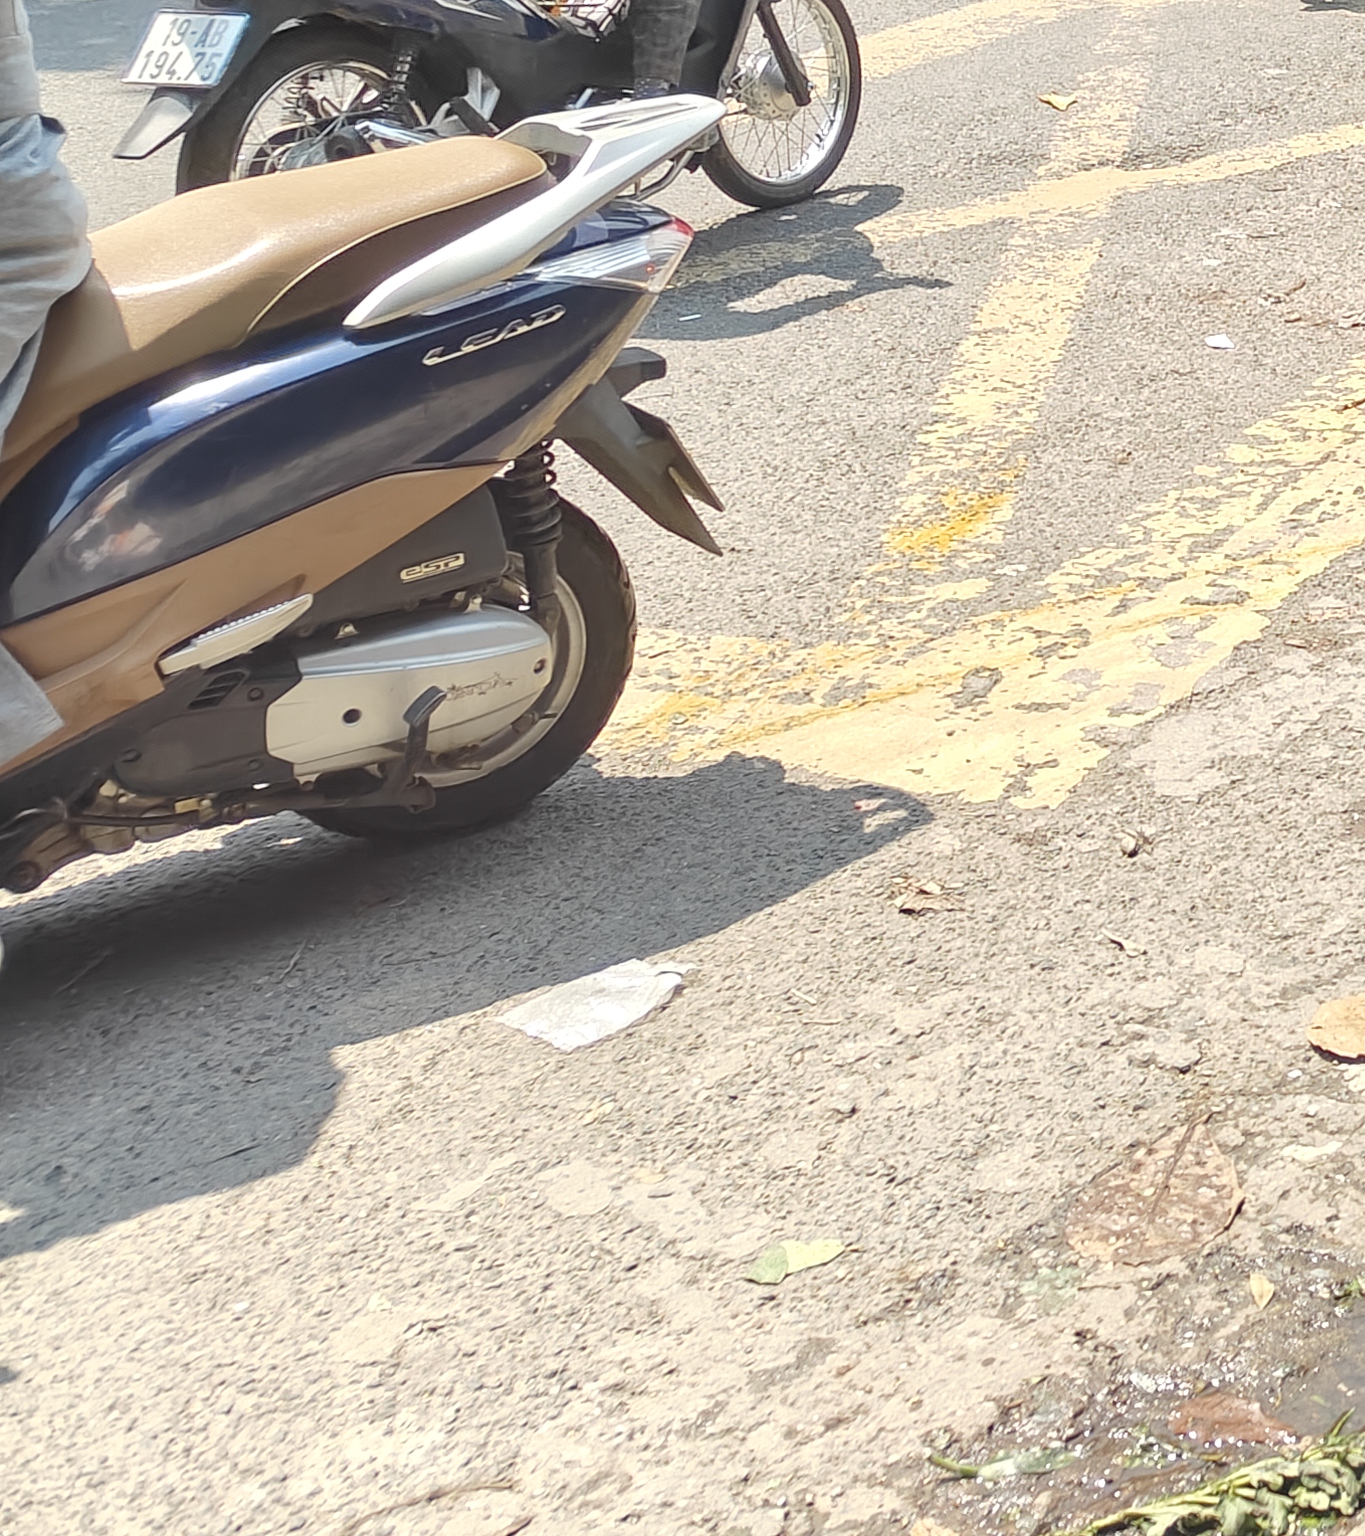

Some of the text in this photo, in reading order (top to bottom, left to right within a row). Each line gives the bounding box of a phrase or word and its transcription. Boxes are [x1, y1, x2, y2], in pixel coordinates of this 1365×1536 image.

[161, 16, 231, 48] 19-AB
[136, 49, 224, 82] 194.75
[421, 303, 567, 367] LEAD
